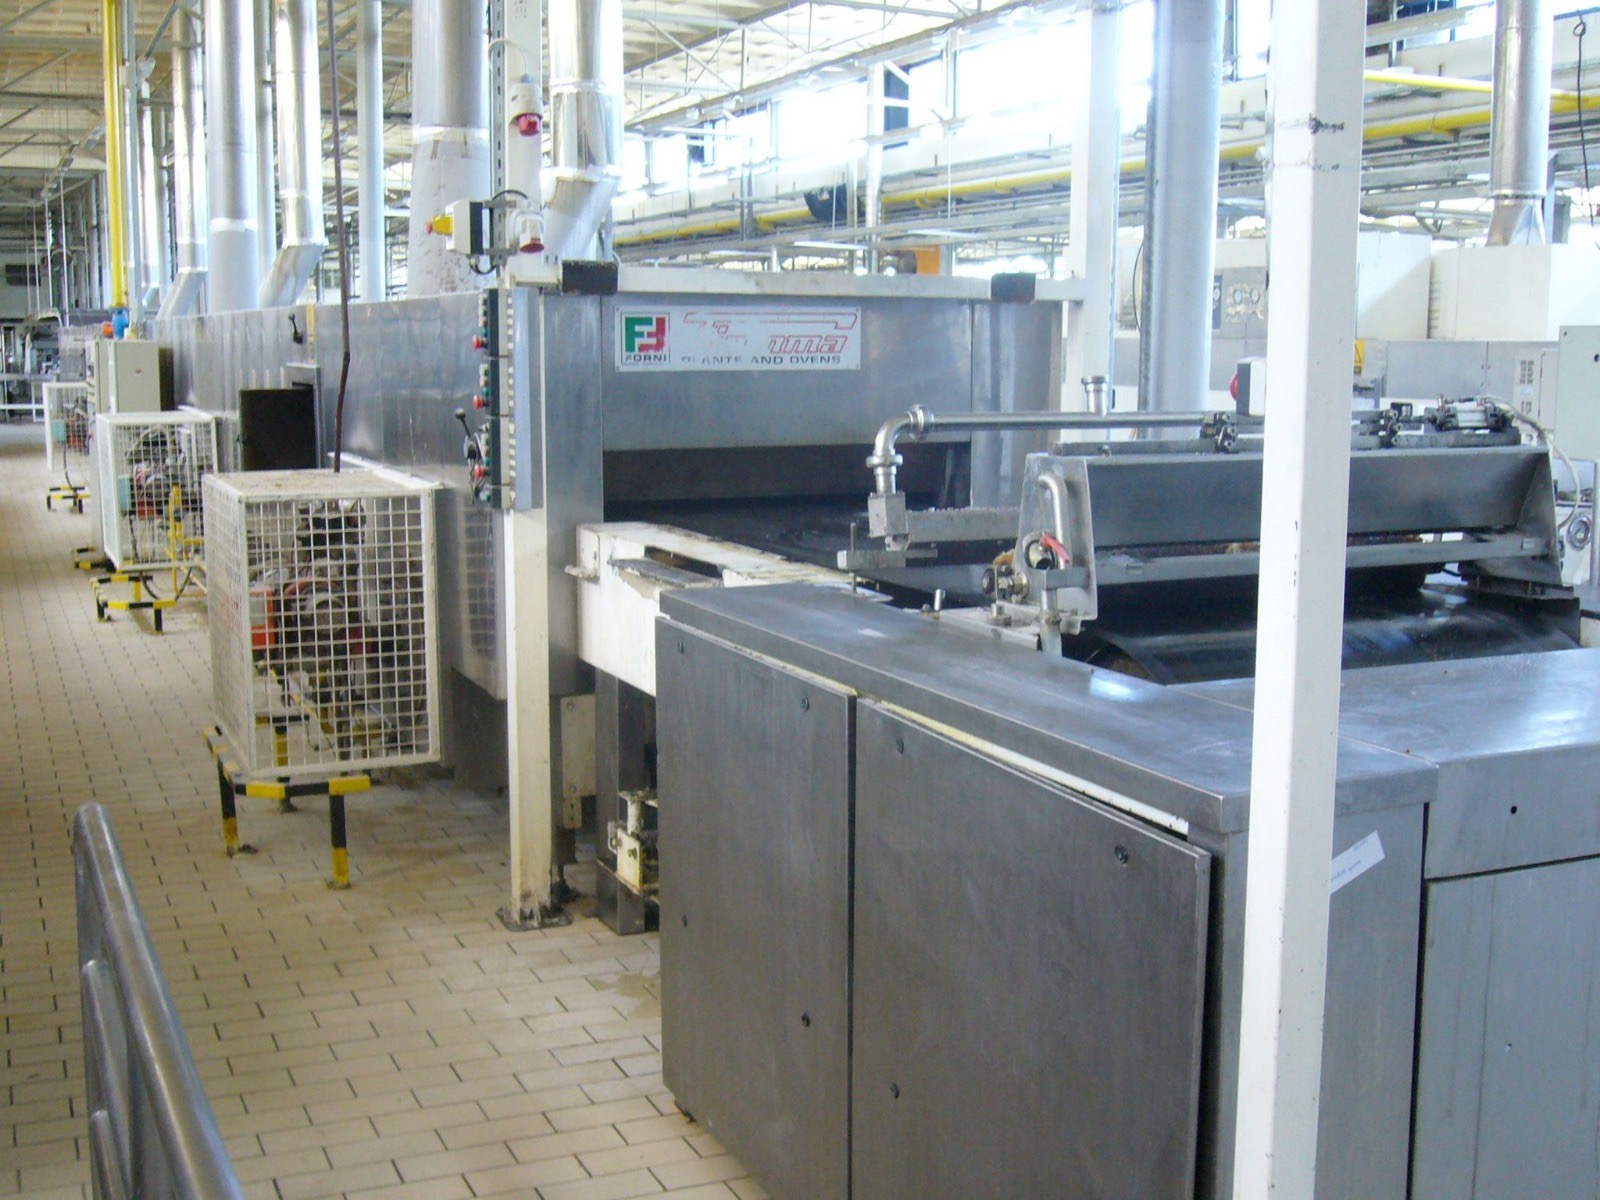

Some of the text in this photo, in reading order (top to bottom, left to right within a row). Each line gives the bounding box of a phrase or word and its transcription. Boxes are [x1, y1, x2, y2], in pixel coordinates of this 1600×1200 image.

[626, 354, 667, 362] FORNI
[751, 356, 784, 365] AND
[789, 355, 841, 364] OVENS
